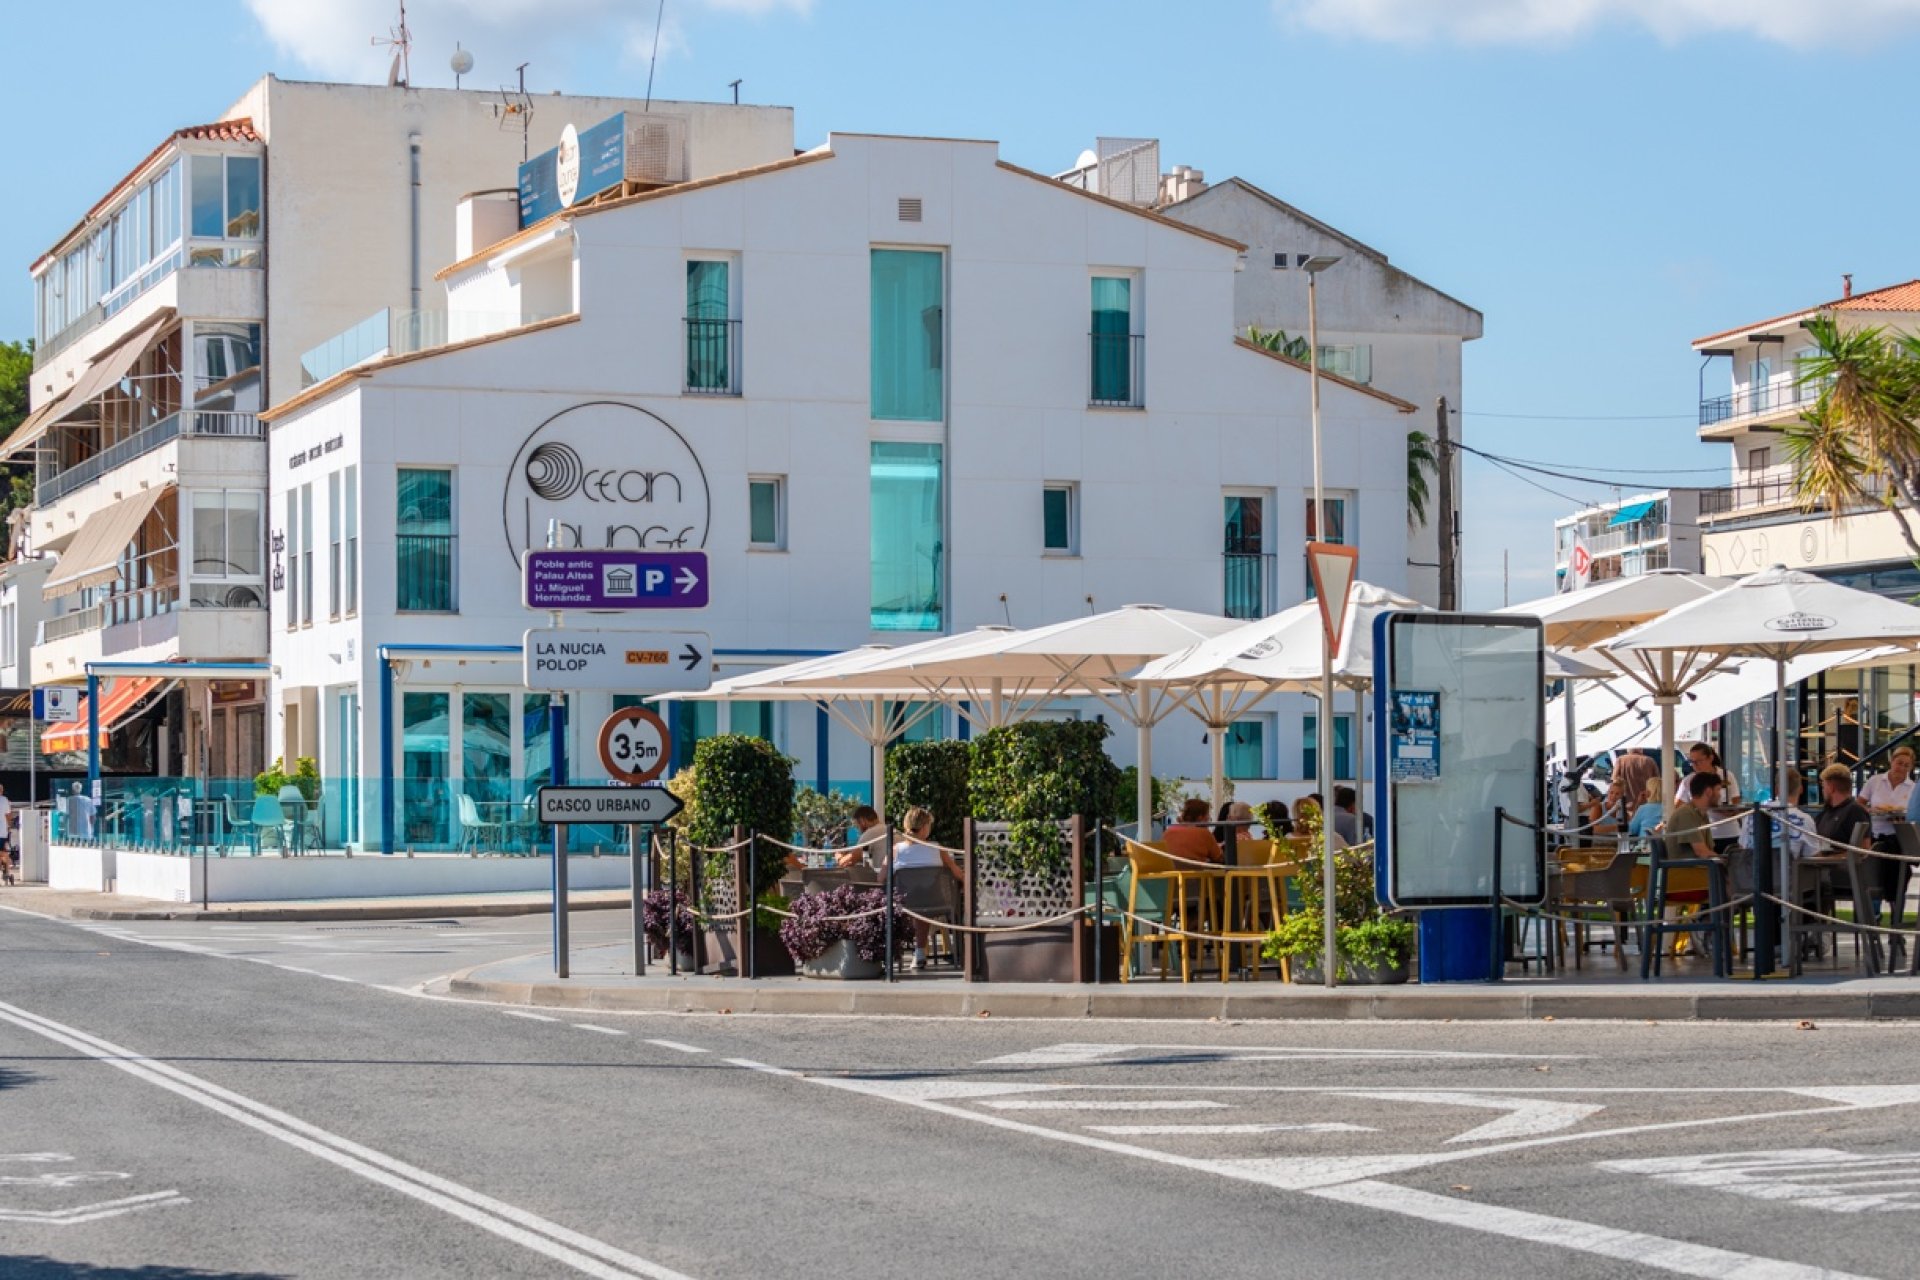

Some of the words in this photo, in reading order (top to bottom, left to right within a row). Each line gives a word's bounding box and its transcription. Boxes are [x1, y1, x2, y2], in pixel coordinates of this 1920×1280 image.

[525, 441, 682, 503] Ocean
[535, 559, 565, 569] Poble
[567, 559, 593, 569] antic
[535, 571, 565, 580] Palau
[566, 571, 594, 580] Altea
[548, 583, 584, 594] Miguel
[535, 592, 592, 602] Hernández
[536, 643, 555, 655] LA
[560, 643, 606, 655] NUCIA
[626, 652, 667, 663] CV-760
[536, 659, 587, 671] POLOP
[547, 798, 592, 812] CASCO
[596, 798, 650, 812] URBANO
